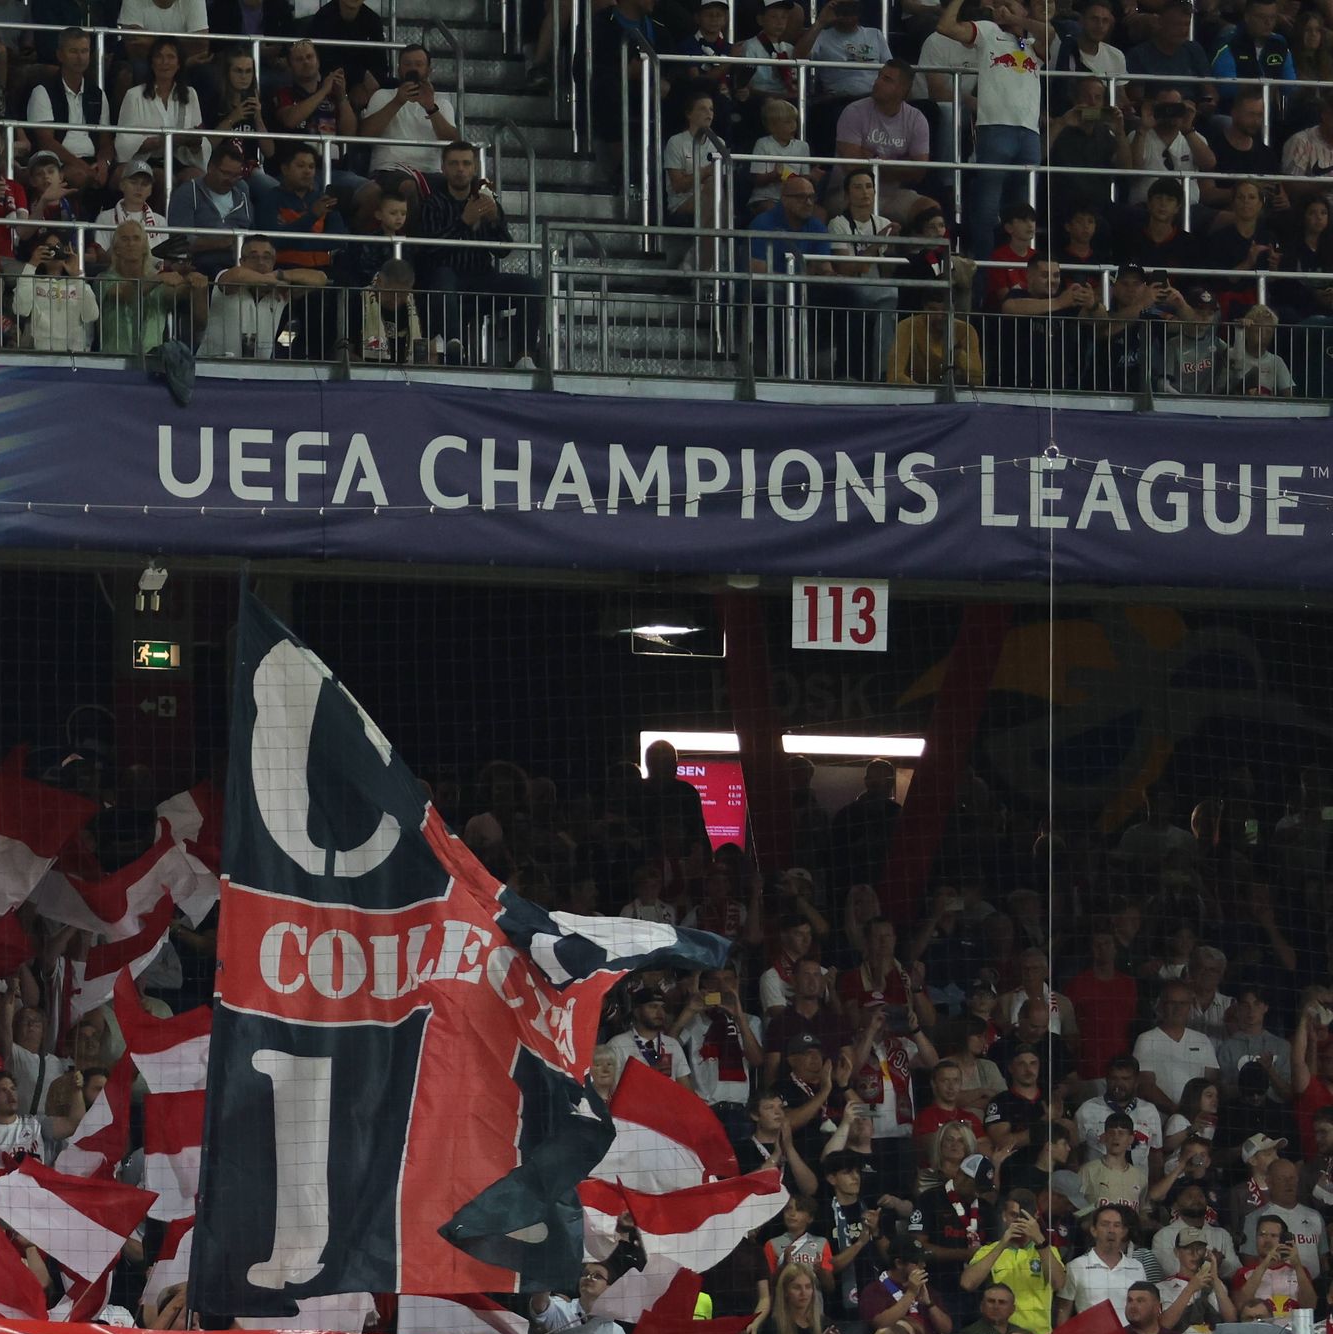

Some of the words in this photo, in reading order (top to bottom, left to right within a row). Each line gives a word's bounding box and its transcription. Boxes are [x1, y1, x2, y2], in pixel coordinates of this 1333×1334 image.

[158, 425, 389, 506] UEFA
[419, 435, 939, 525] CHAMPIONS
[981, 455, 1306, 536] LEAGUE
[803, 584, 877, 646] 113
